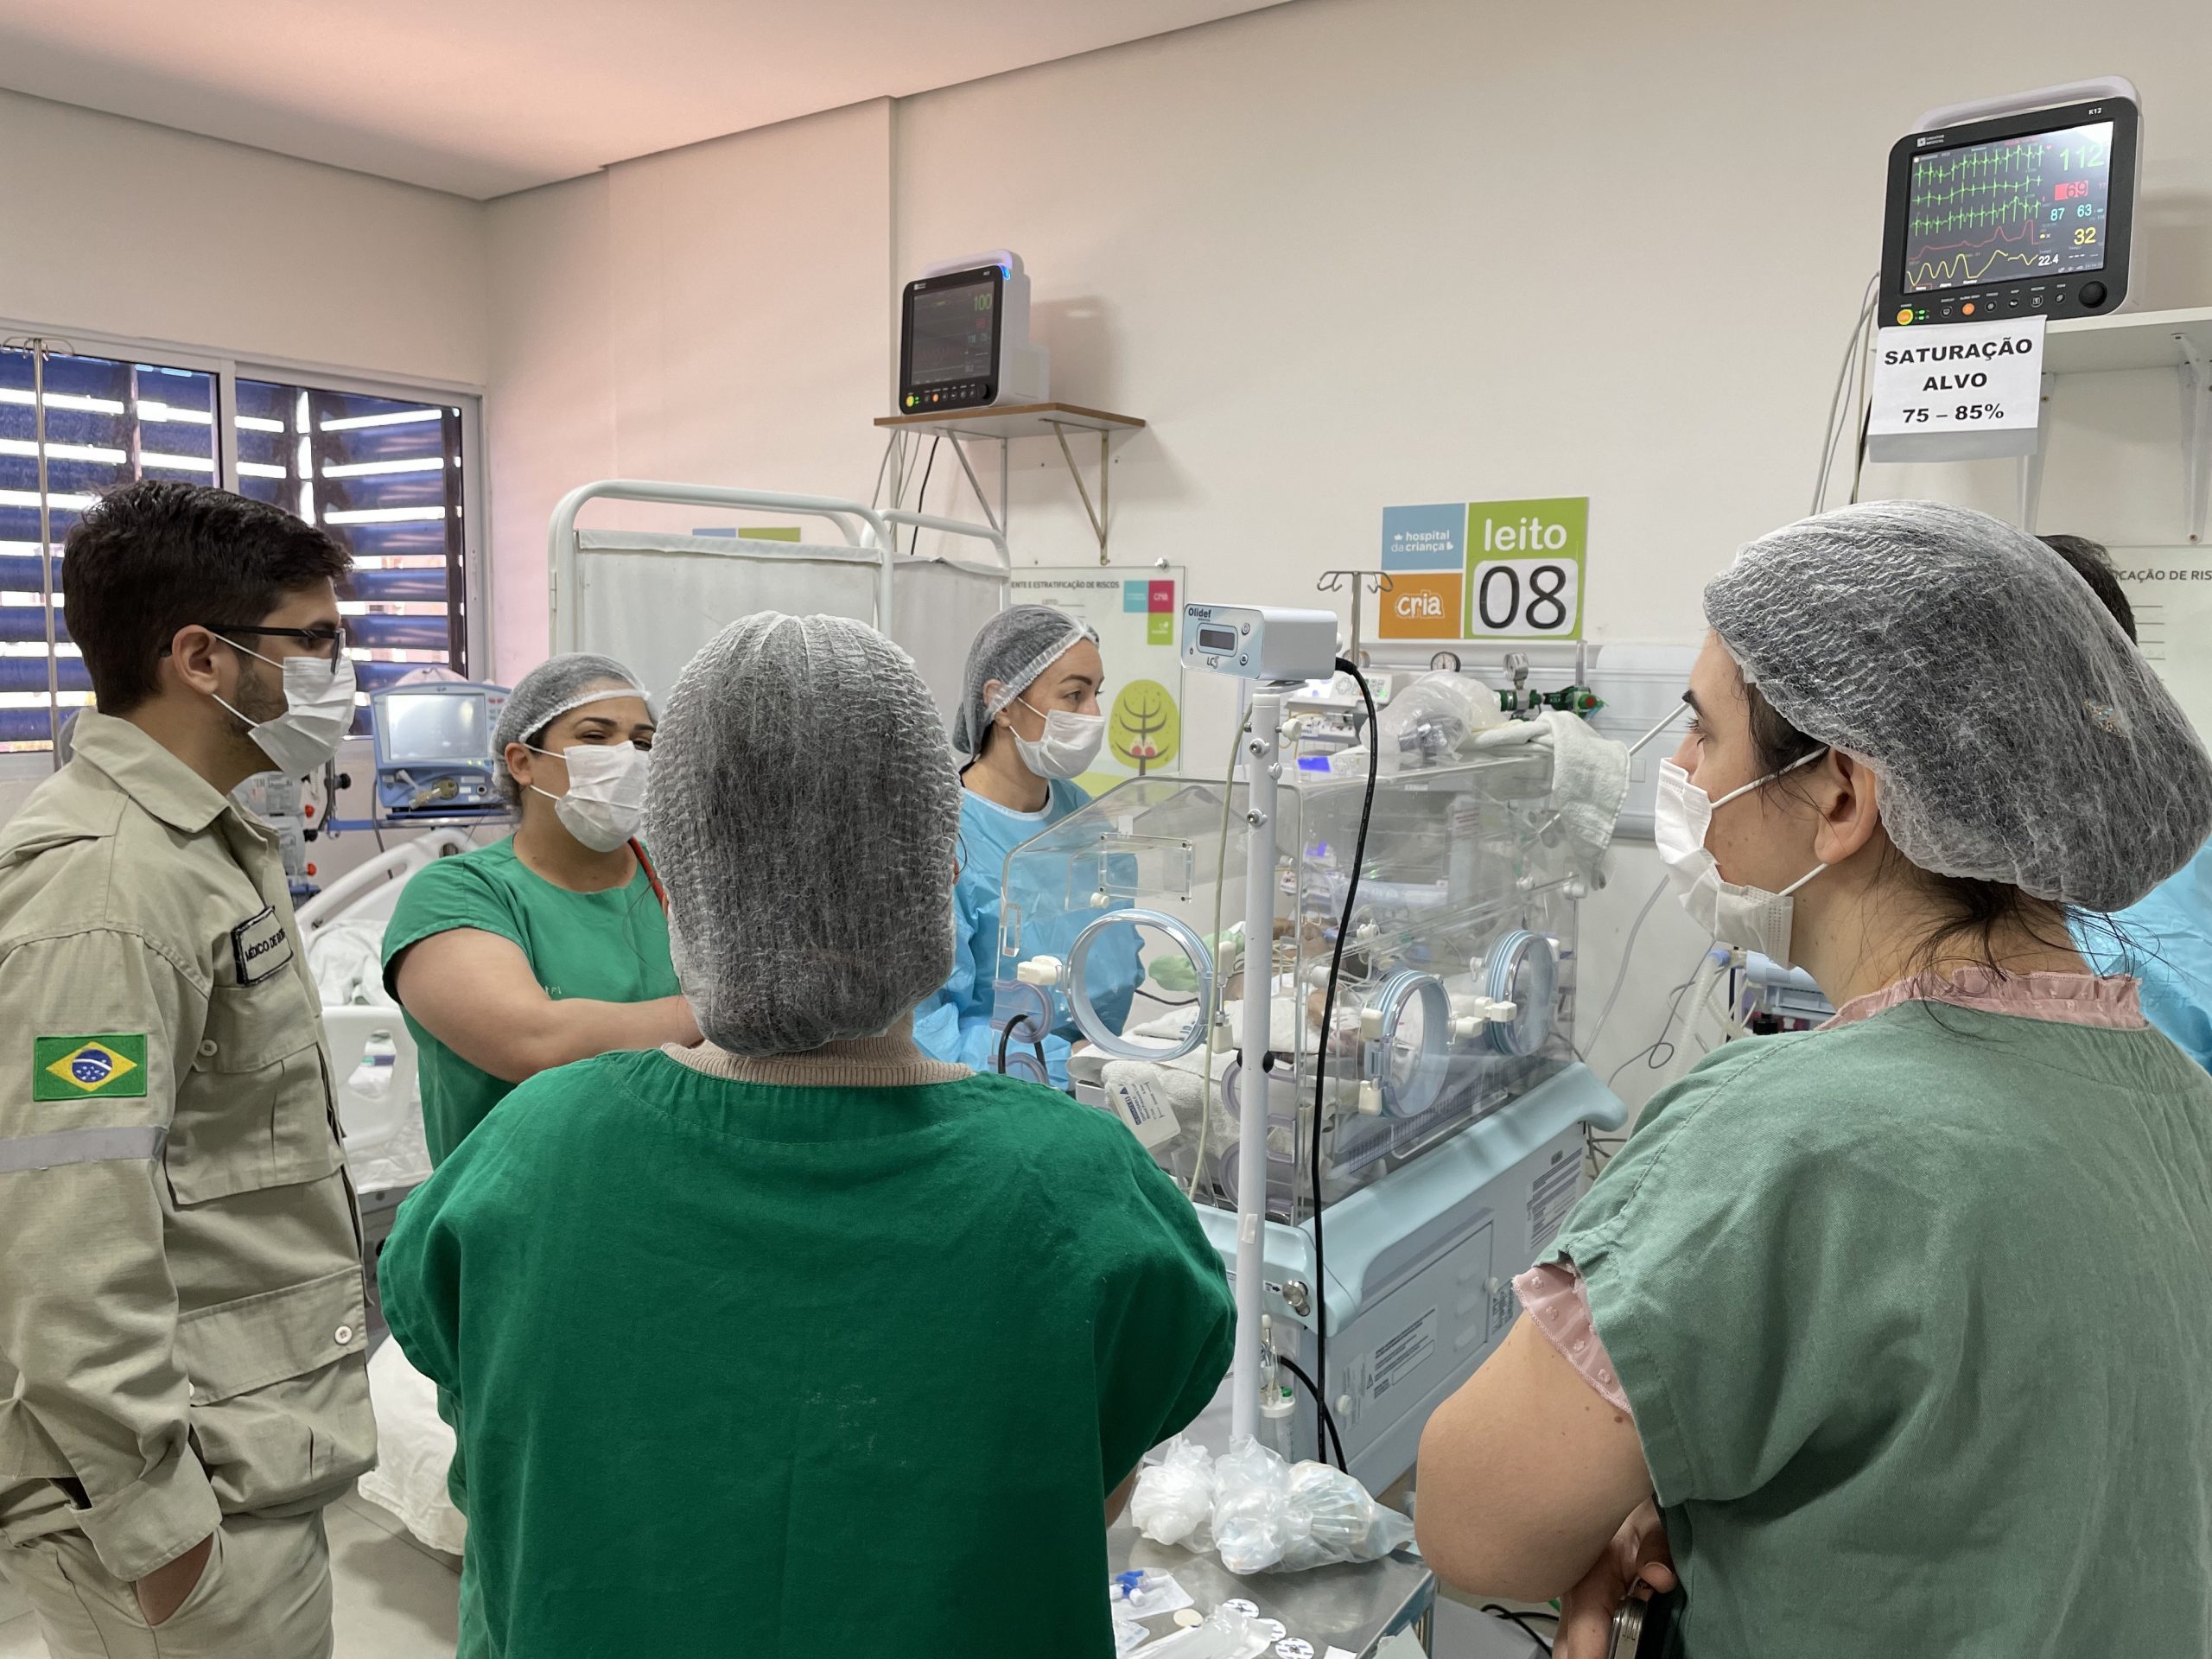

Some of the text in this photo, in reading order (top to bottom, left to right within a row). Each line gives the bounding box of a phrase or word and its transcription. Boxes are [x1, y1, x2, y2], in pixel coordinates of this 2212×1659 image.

[2059, 144, 2104, 171] 112
[2066, 181, 2088, 198] 69
[2050, 207, 2065, 221] 87
[2076, 203, 2092, 218] 63
[2073, 226, 2096, 245] 32
[2037, 253, 2059, 266] 22.4
[974, 293, 993, 311] 100
[1884, 336, 2033, 365] SATURAÇÃO
[1923, 372, 1987, 391] ALVO
[1903, 408, 1929, 423] 75
[1955, 403, 2005, 421] 85%
[1405, 530, 1450, 542] hospital
[1484, 517, 1567, 552] leito
[1391, 541, 1445, 553] da criança
[1033, 580, 1085, 589] ESTRATIFICAÇÃO
[2169, 570, 2188, 581] DE
[1396, 593, 1443, 618] cria
[1479, 564, 1567, 630] 08
[1188, 607, 1212, 619] Olidef
[245, 940, 270, 962] MÉDICO
[270, 934, 278, 948] DE
